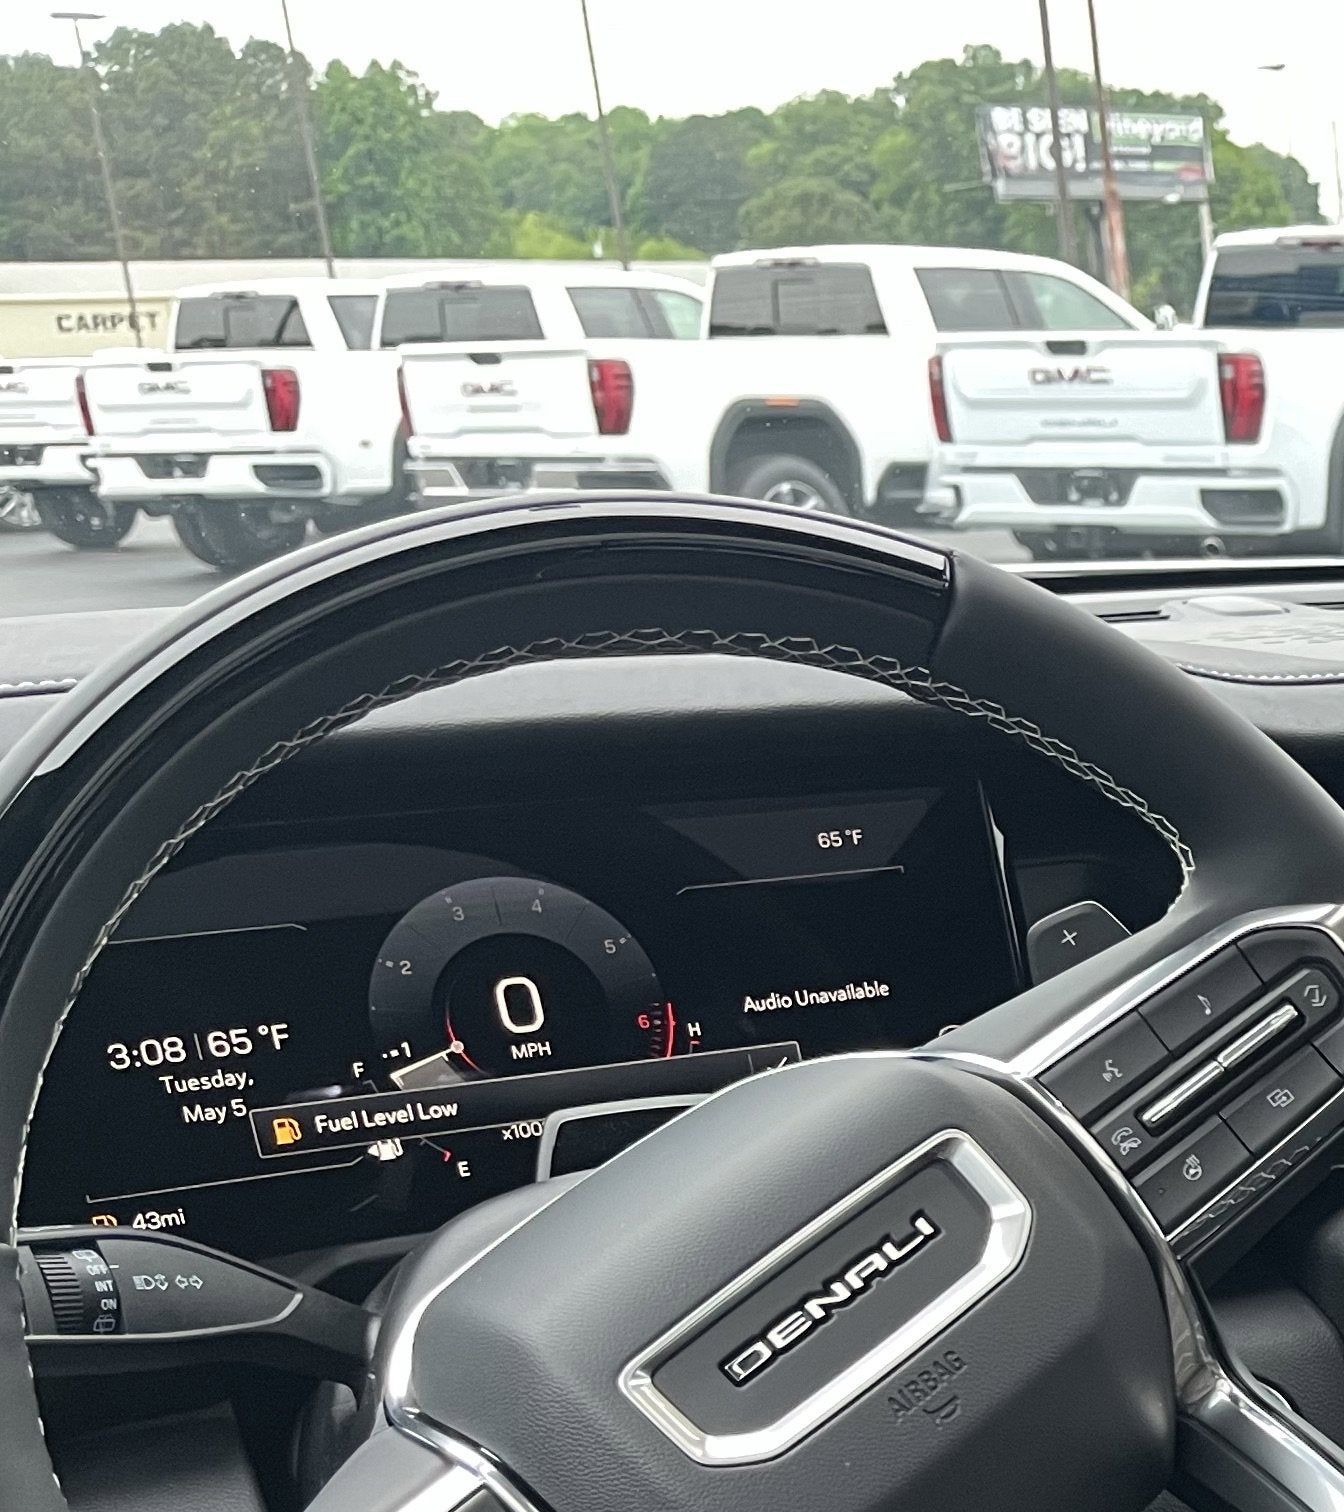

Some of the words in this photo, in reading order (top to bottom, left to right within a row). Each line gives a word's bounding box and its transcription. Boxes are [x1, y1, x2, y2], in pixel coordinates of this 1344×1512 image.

[56, 311, 161, 333] CARPET
[1028, 366, 1113, 386] GMC
[817, 832, 843, 849] 65
[451, 907, 465, 922] 3
[531, 900, 543, 914] 4
[604, 938, 616, 954] 5
[400, 961, 412, 975] 2
[495, 976, 545, 1034] 0
[743, 992, 793, 1013] Audio
[795, 981, 890, 1006] Unavailable
[637, 1015, 651, 1029] 6
[687, 1023, 700, 1036] H
[107, 1036, 186, 1069] 3:08
[207, 1029, 252, 1058] 65
[511, 1042, 552, 1060] MPH
[353, 1062, 364, 1078] F
[160, 1069, 254, 1094] Tuesday,
[183, 1105, 228, 1125] May
[233, 1098, 247, 1117] 5
[315, 1113, 361, 1134] Fuel
[367, 1106, 413, 1128] Level
[417, 1101, 458, 1122] Low
[458, 1162, 470, 1177] E
[132, 1209, 186, 1231] 43mi
[86, 1264, 109, 1276] OFF
[95, 1280, 114, 1292] INT
[101, 1298, 117, 1311] ON
[725, 1216, 935, 1381] DENALI
[887, 1350, 967, 1420] AIRBAG
